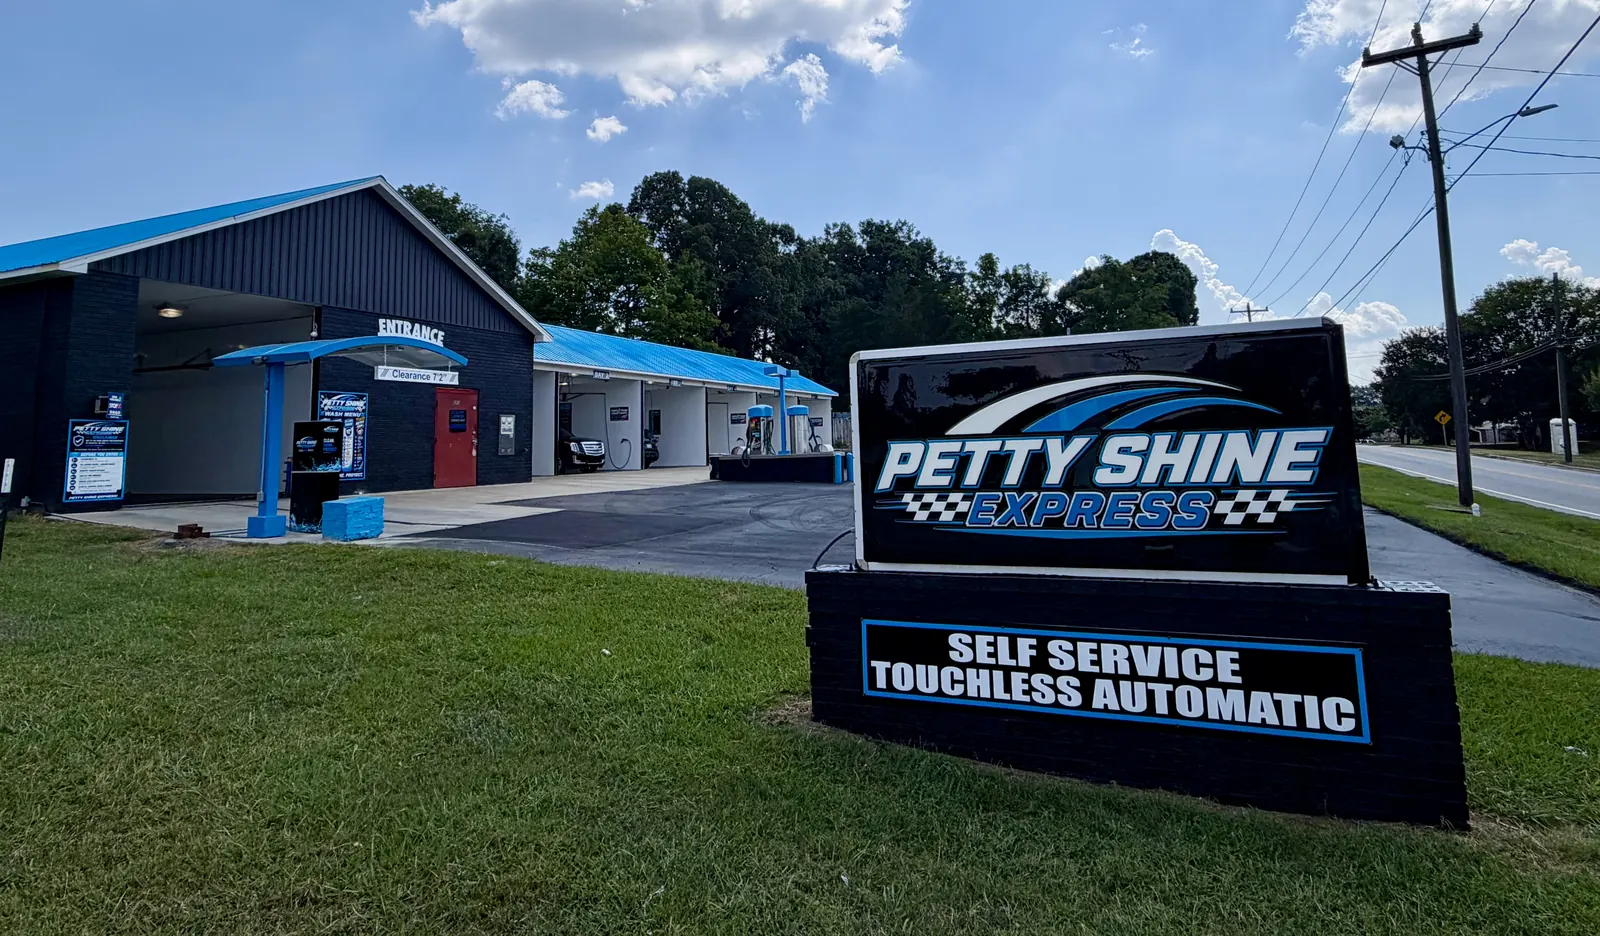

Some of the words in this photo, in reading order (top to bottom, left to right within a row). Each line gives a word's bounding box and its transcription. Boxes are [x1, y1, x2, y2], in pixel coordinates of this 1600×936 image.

[378, 318, 445, 346] ENTRANCE
[392, 369, 431, 381] Clearance
[321, 399, 346, 407] PETTY
[874, 434, 1098, 493] PETTY
[1094, 426, 1334, 486] SHINE
[965, 490, 1217, 531] EXPRESS
[947, 632, 1038, 668] SELF
[1047, 638, 1243, 685] SERVICE
[870, 660, 1083, 708] TOUCHLESS
[1091, 678, 1356, 732] AUTOMATIC
